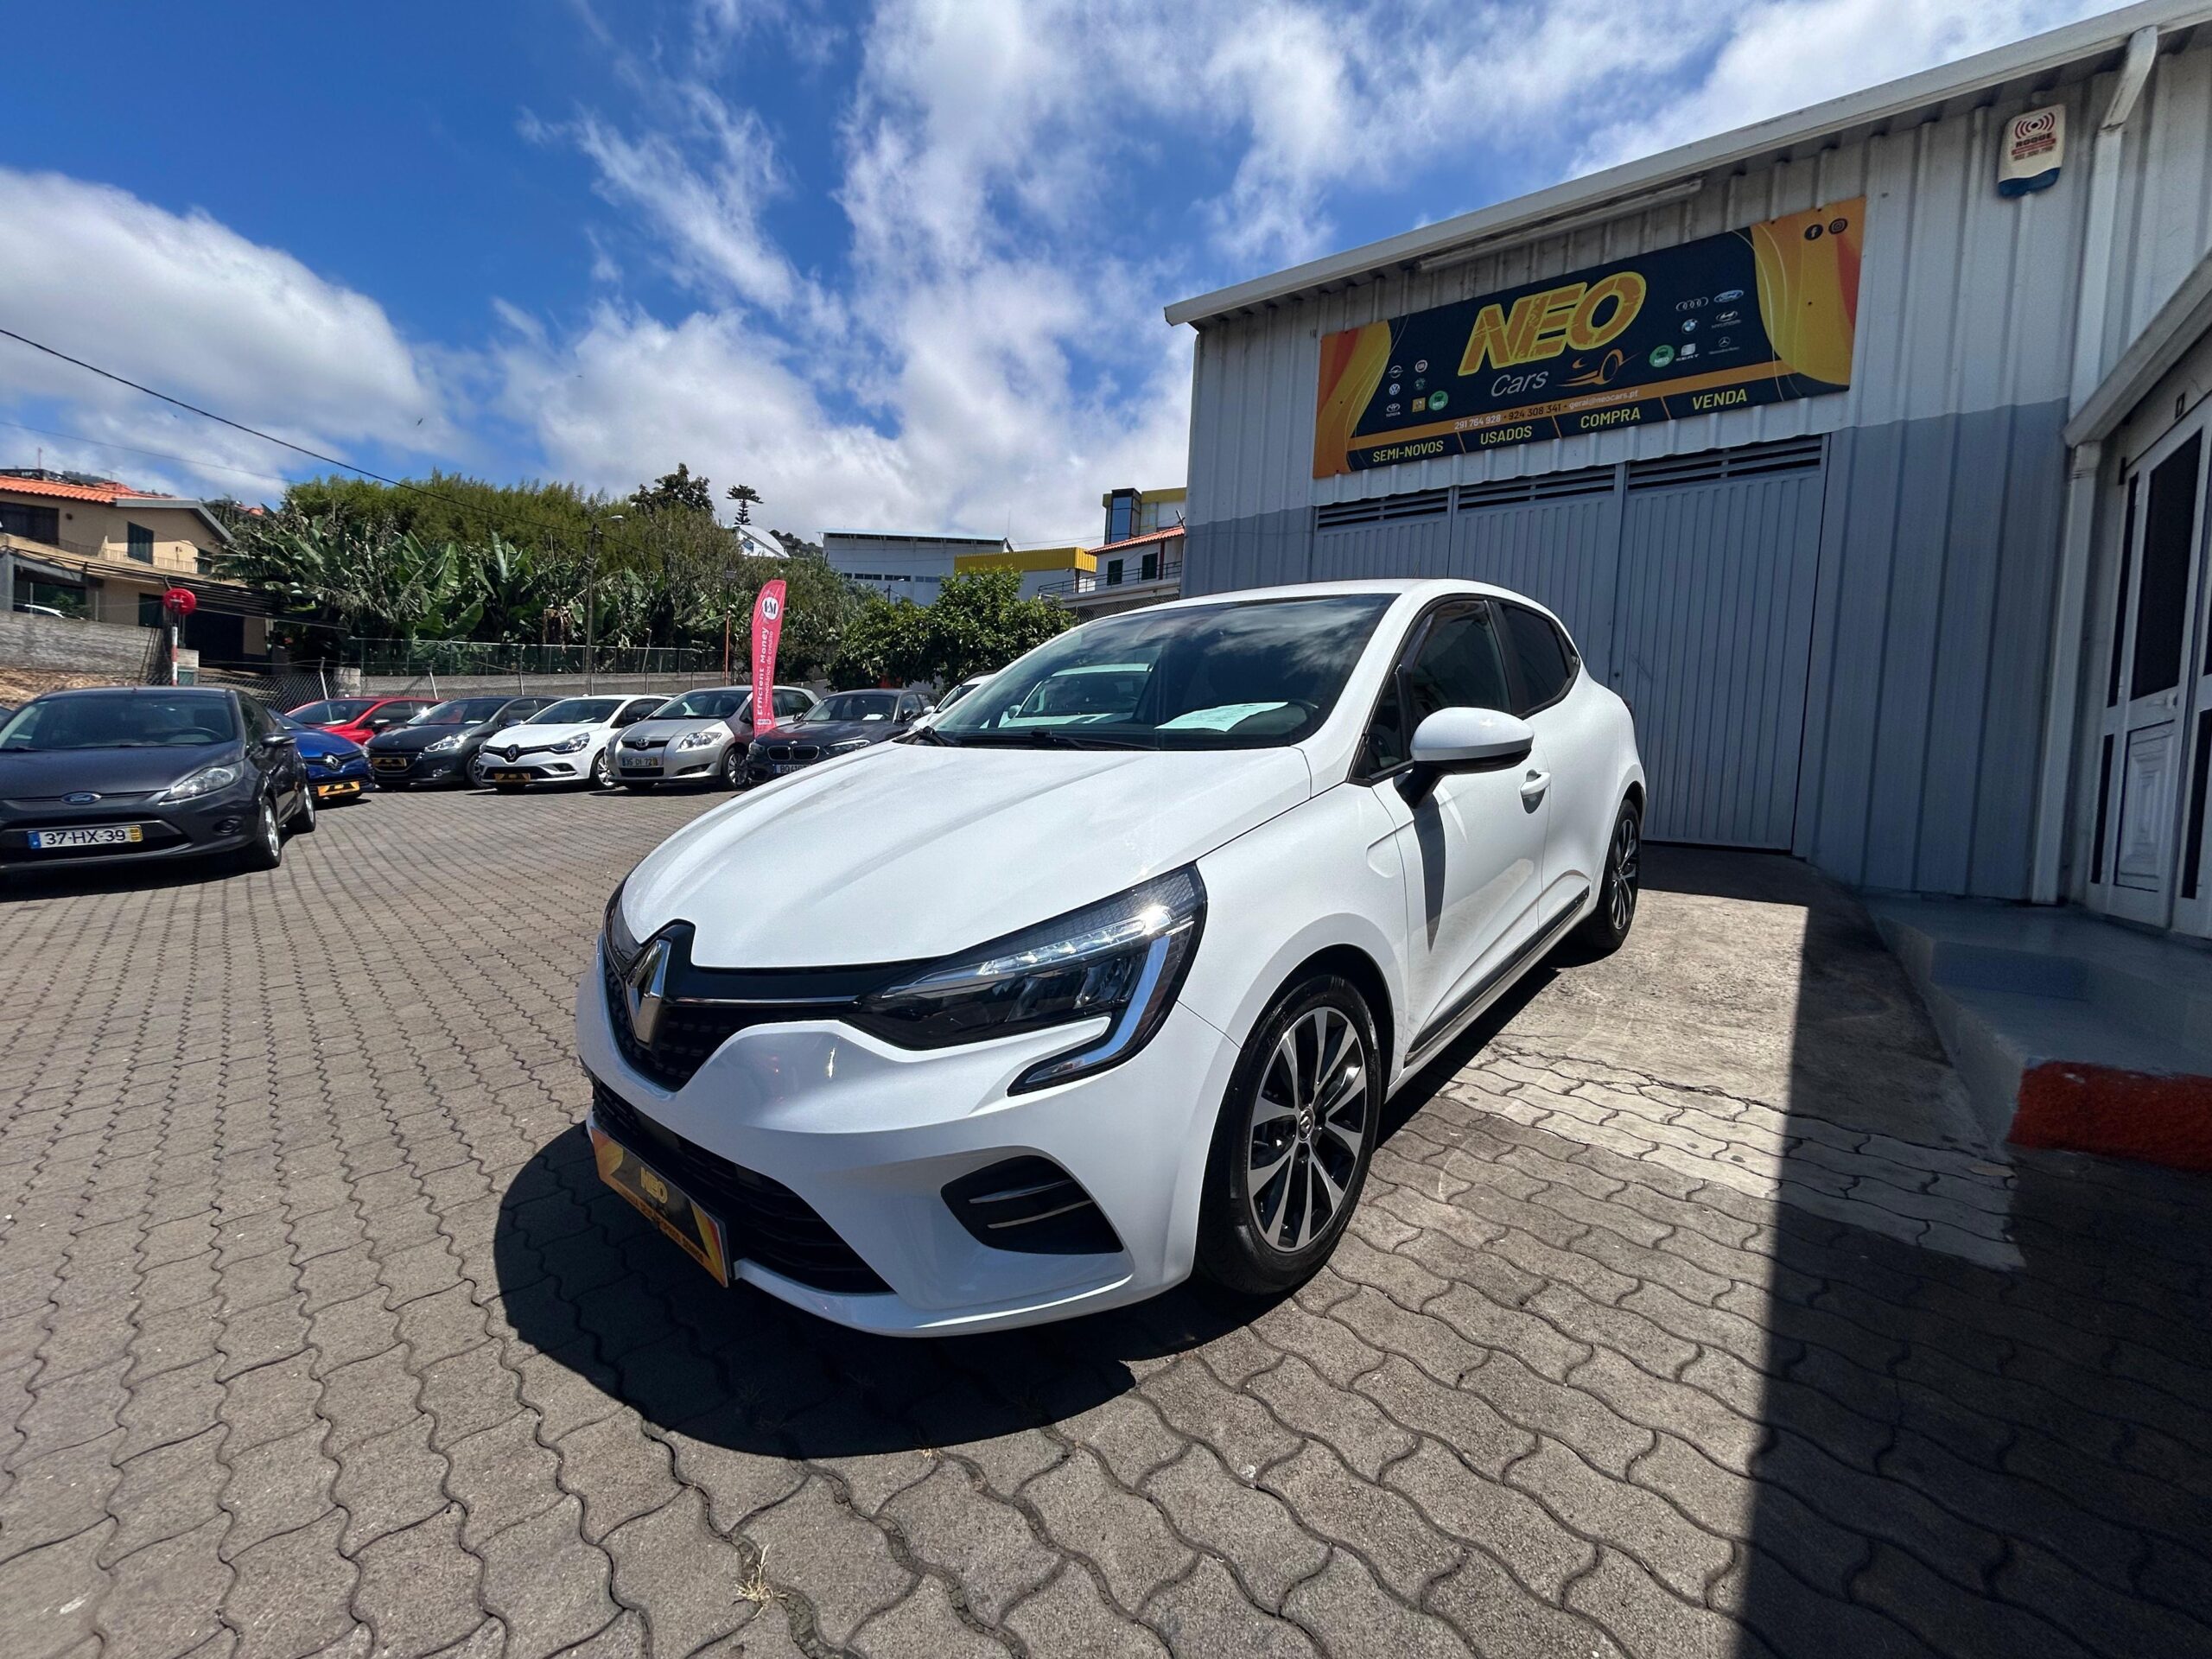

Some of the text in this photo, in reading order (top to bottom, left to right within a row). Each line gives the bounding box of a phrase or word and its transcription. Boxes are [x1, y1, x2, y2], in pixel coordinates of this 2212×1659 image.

[1458, 271, 1646, 376] NEO
[1491, 372, 1548, 397] Cars
[1454, 420, 1467, 430] 291
[1485, 414, 1502, 424] 928
[1509, 410, 1525, 420] 924
[1527, 406, 1544, 416] 308
[1546, 404, 1561, 415] 341
[1568, 389, 1638, 410] geral@neocars.pt
[1693, 388, 1747, 410] VENDA
[1580, 407, 1641, 429] COMPRA
[1480, 425, 1533, 445] USADOS
[1373, 441, 1444, 462] SEMI-NOVOS
[760, 626, 769, 664] Money
[45, 829, 126, 845] 37-HX-39
